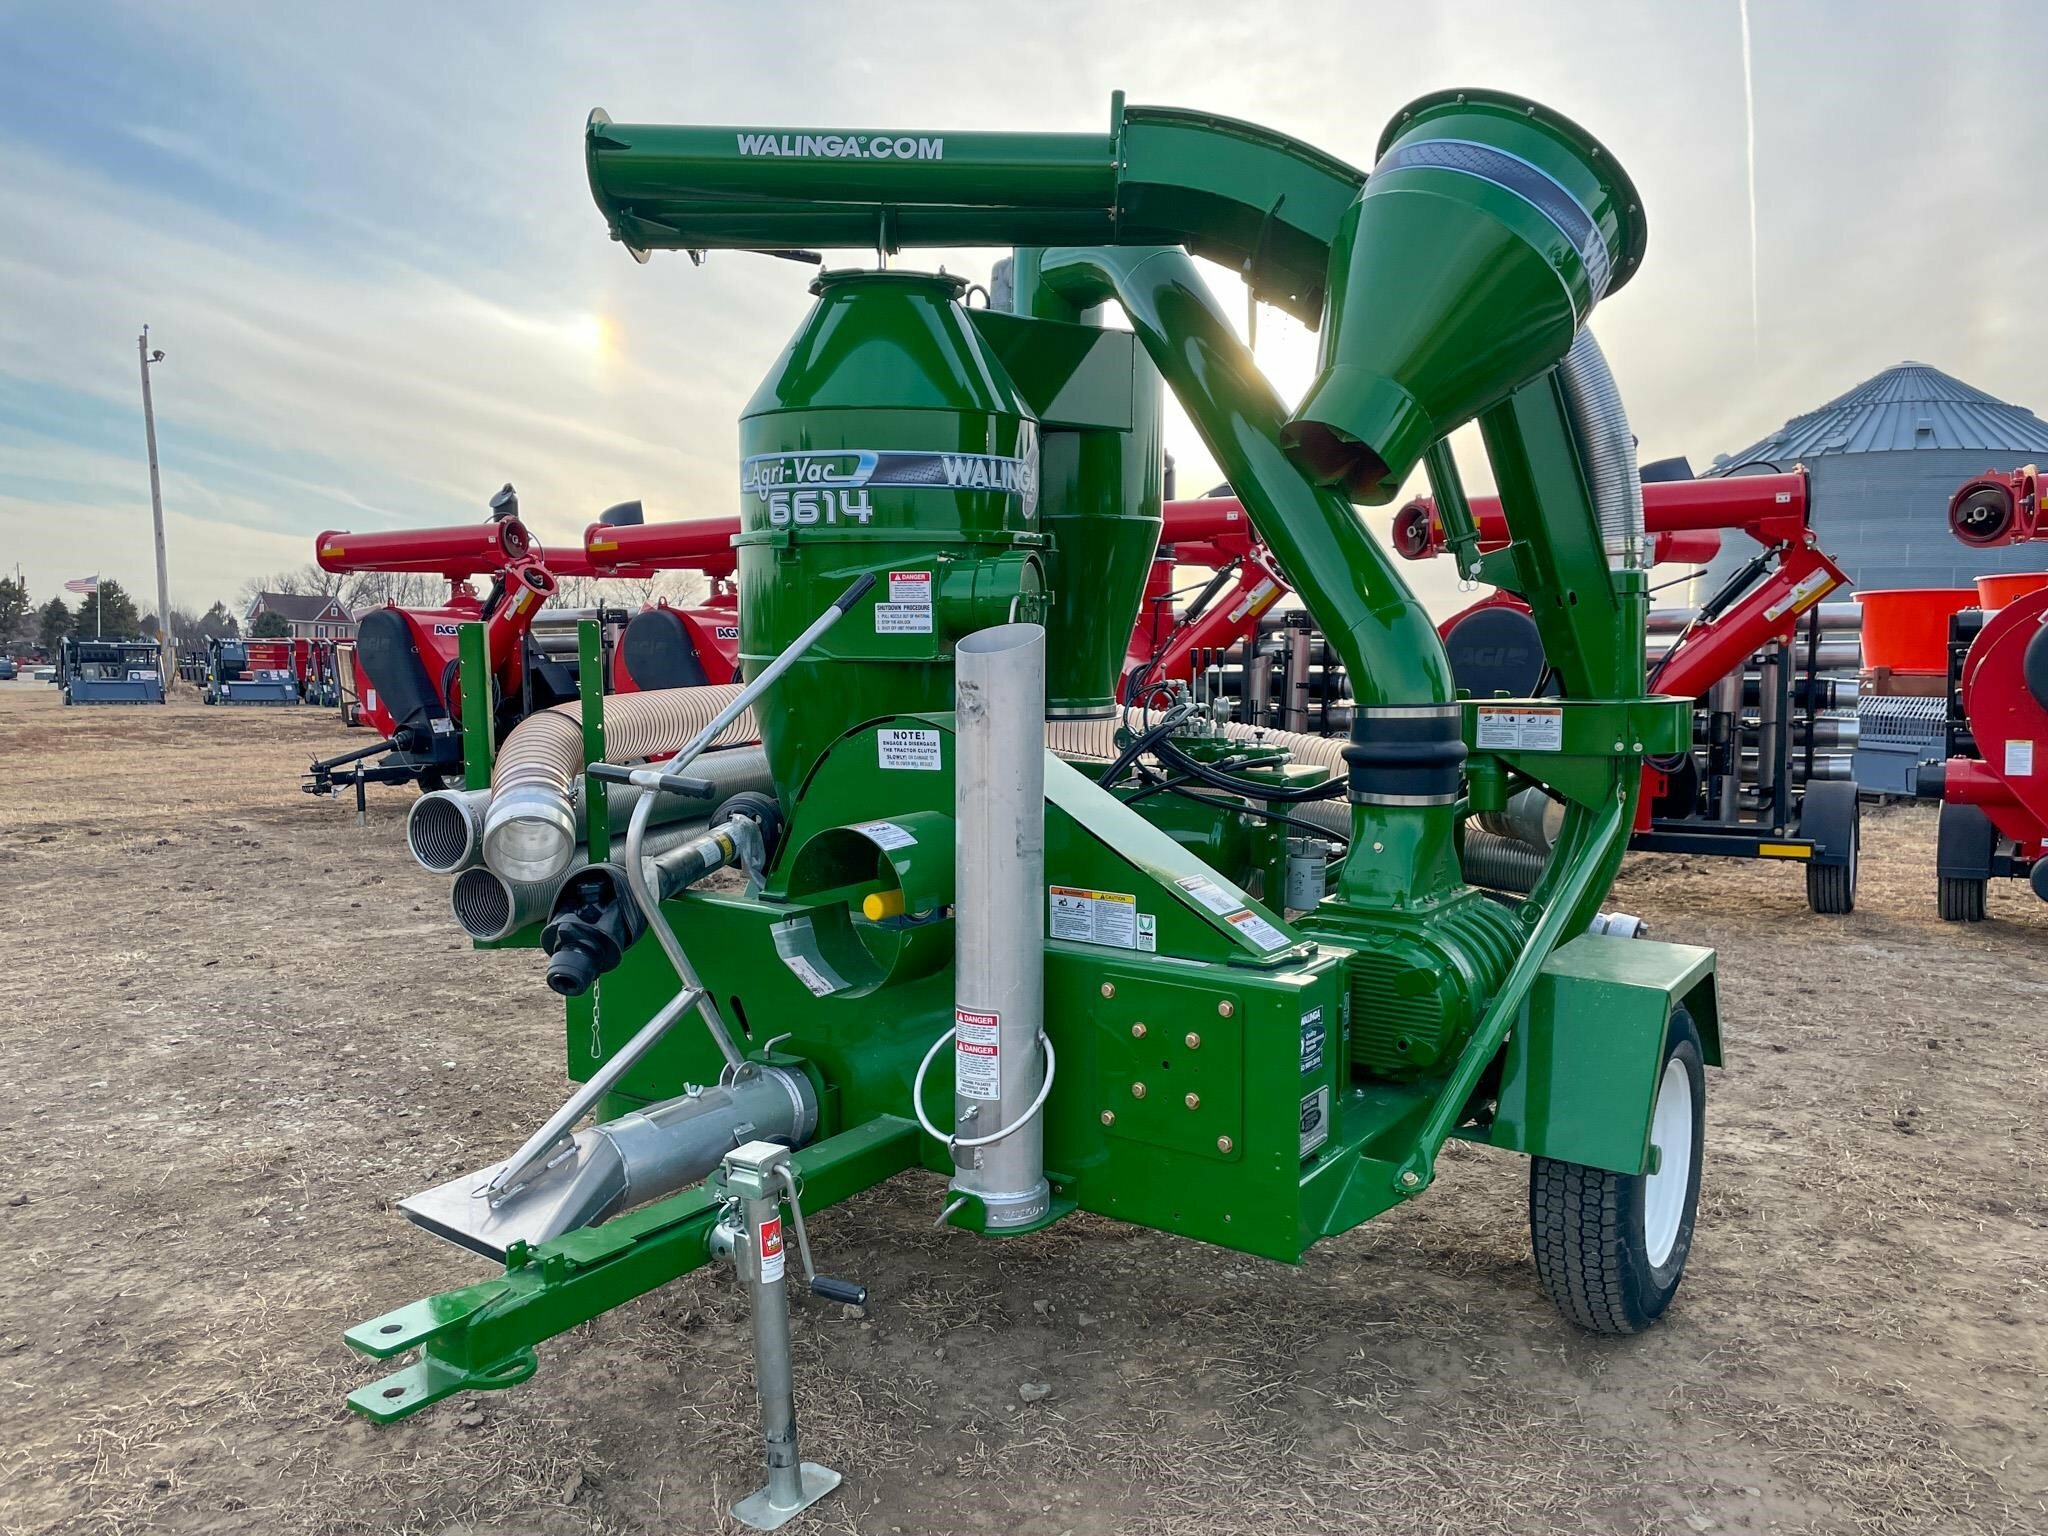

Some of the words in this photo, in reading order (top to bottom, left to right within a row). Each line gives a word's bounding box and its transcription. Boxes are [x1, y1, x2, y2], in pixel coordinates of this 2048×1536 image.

[751, 457, 835, 501] Agri-Vac
[769, 490, 873, 526] 6614
[893, 731, 925, 740] NOTE!
[1104, 894, 1126, 902] CAUTION
[964, 1014, 993, 1025] DANGER
[964, 1044, 994, 1055] DANGER
